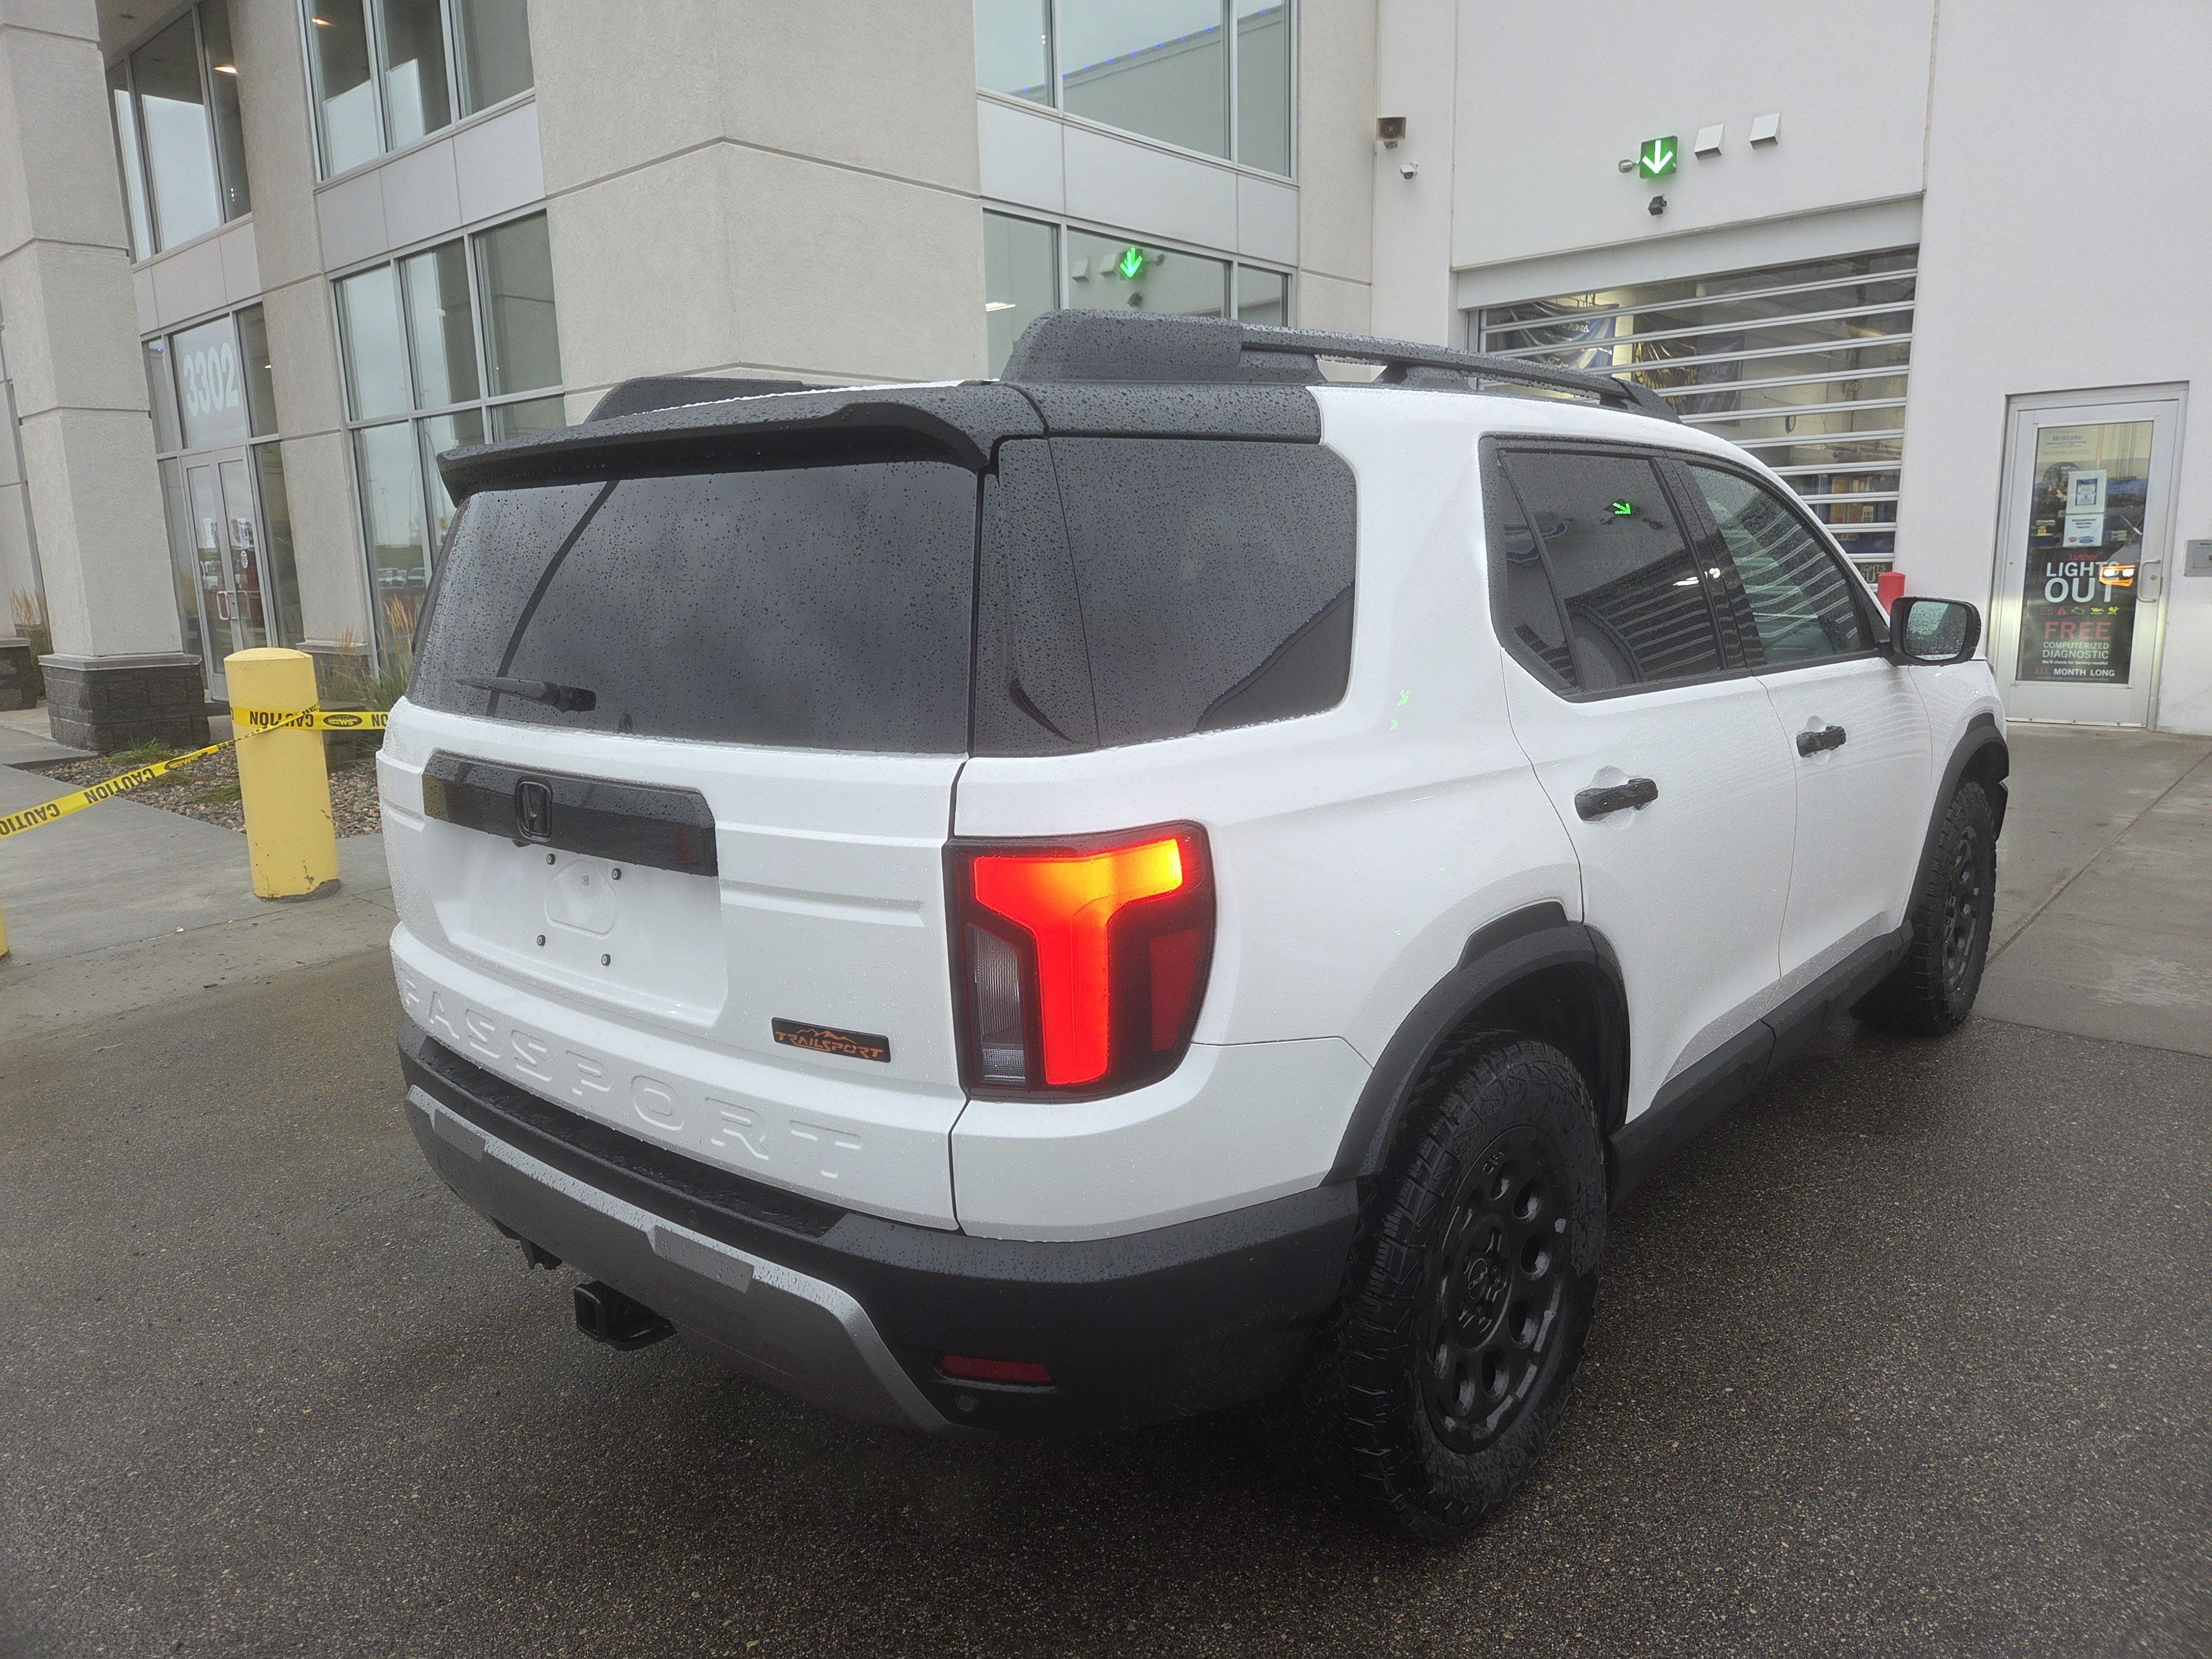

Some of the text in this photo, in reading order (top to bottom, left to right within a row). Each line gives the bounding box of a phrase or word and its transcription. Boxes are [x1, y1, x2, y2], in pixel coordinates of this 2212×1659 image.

[183, 343, 239, 417] 3302
[2044, 577, 2120, 603] OUT
[2044, 621, 2112, 640] FREE
[2042, 650, 2109, 659] DIAGNOSTIC
[2043, 641, 2110, 650] COMPUTERIZED
[2053, 668, 2086, 676] MONTH
[2090, 669, 2115, 677] LONG
[83, 768, 156, 805] CAUTION
[775, 1030, 883, 1059] TRAILSPORT
[398, 966, 862, 1178] PASSPORT
